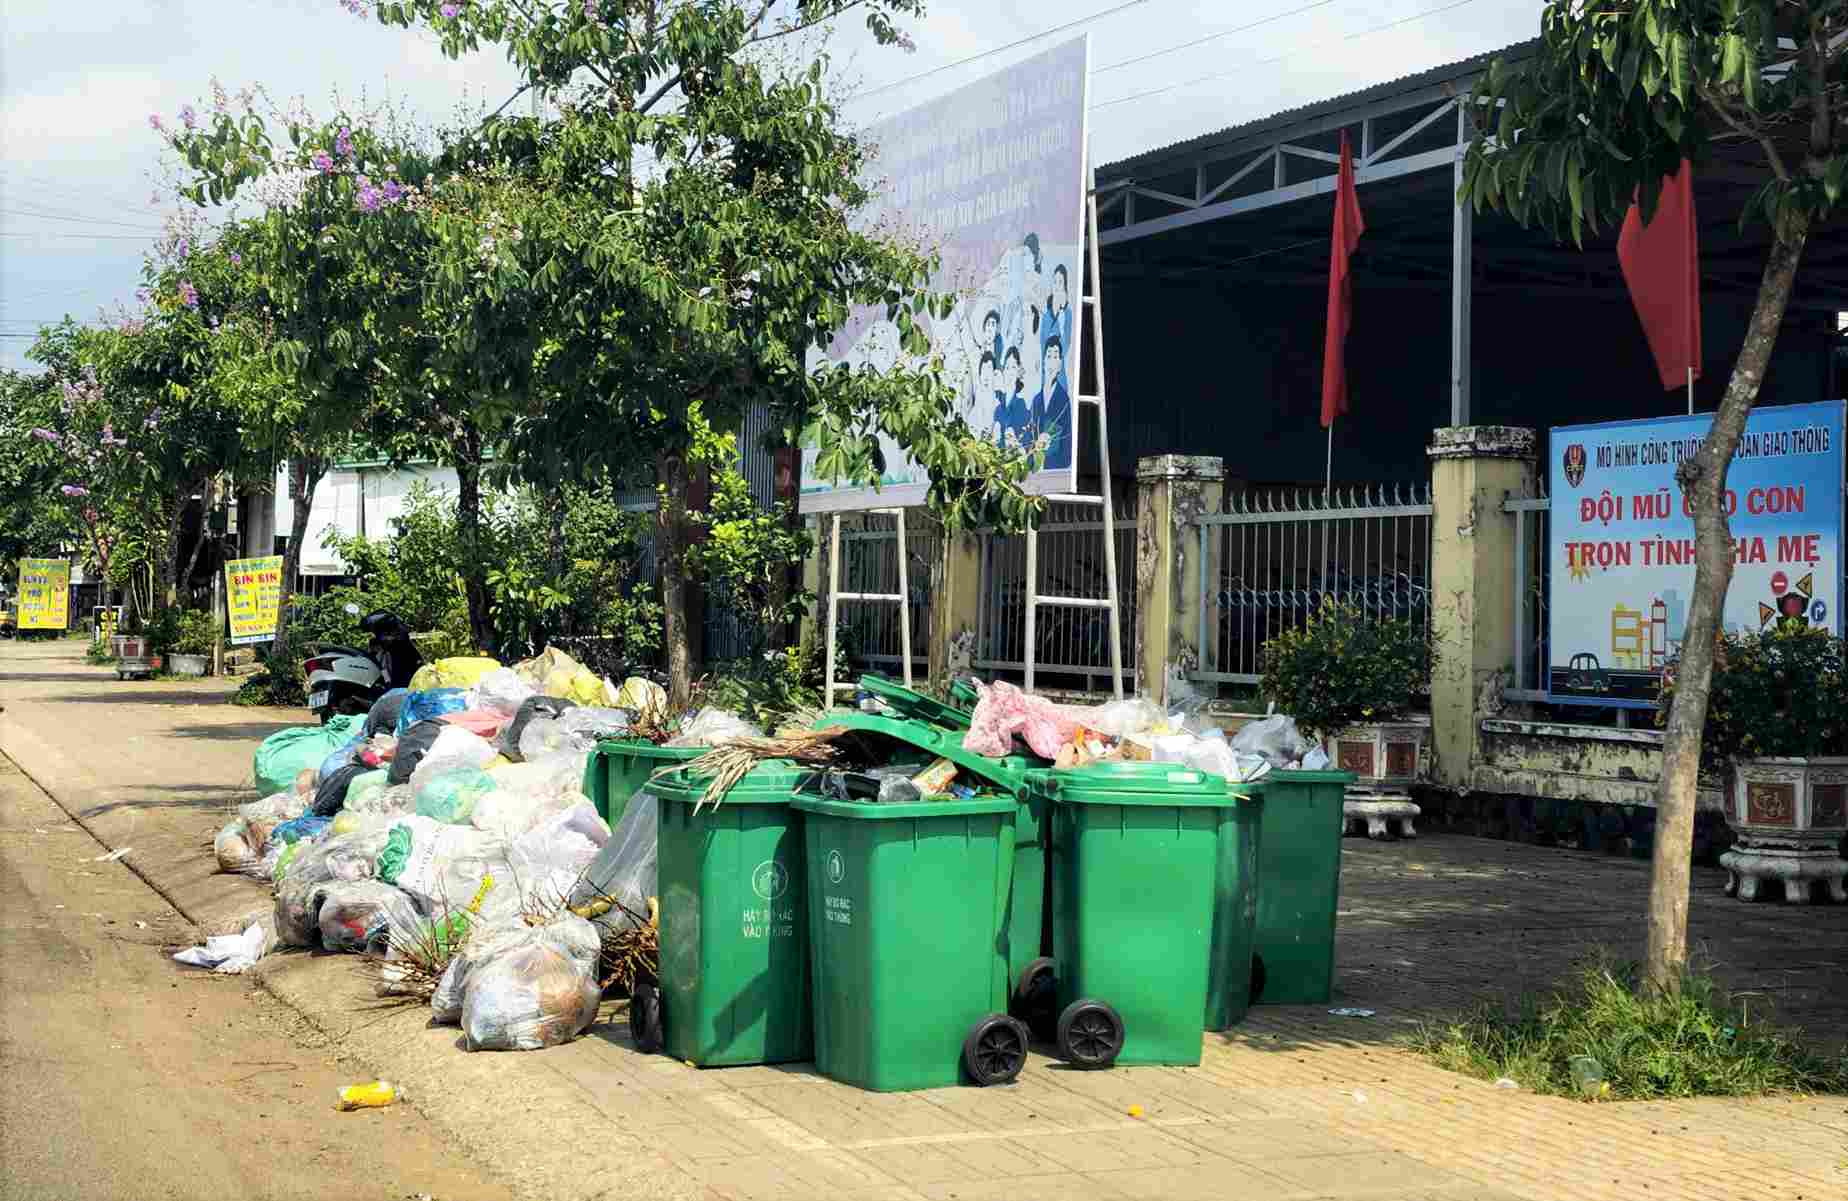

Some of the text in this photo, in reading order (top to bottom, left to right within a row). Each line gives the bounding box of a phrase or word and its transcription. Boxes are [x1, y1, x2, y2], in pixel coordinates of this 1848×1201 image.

[1736, 428, 1760, 458] OÀN
[1763, 431, 1788, 457] GIAO
[1791, 424, 1830, 455] THÔNG
[1579, 487, 1805, 526] ĐỘI MŨ CO CON
[1564, 533, 1821, 572] TRỌN TÌNH HA MẸ
